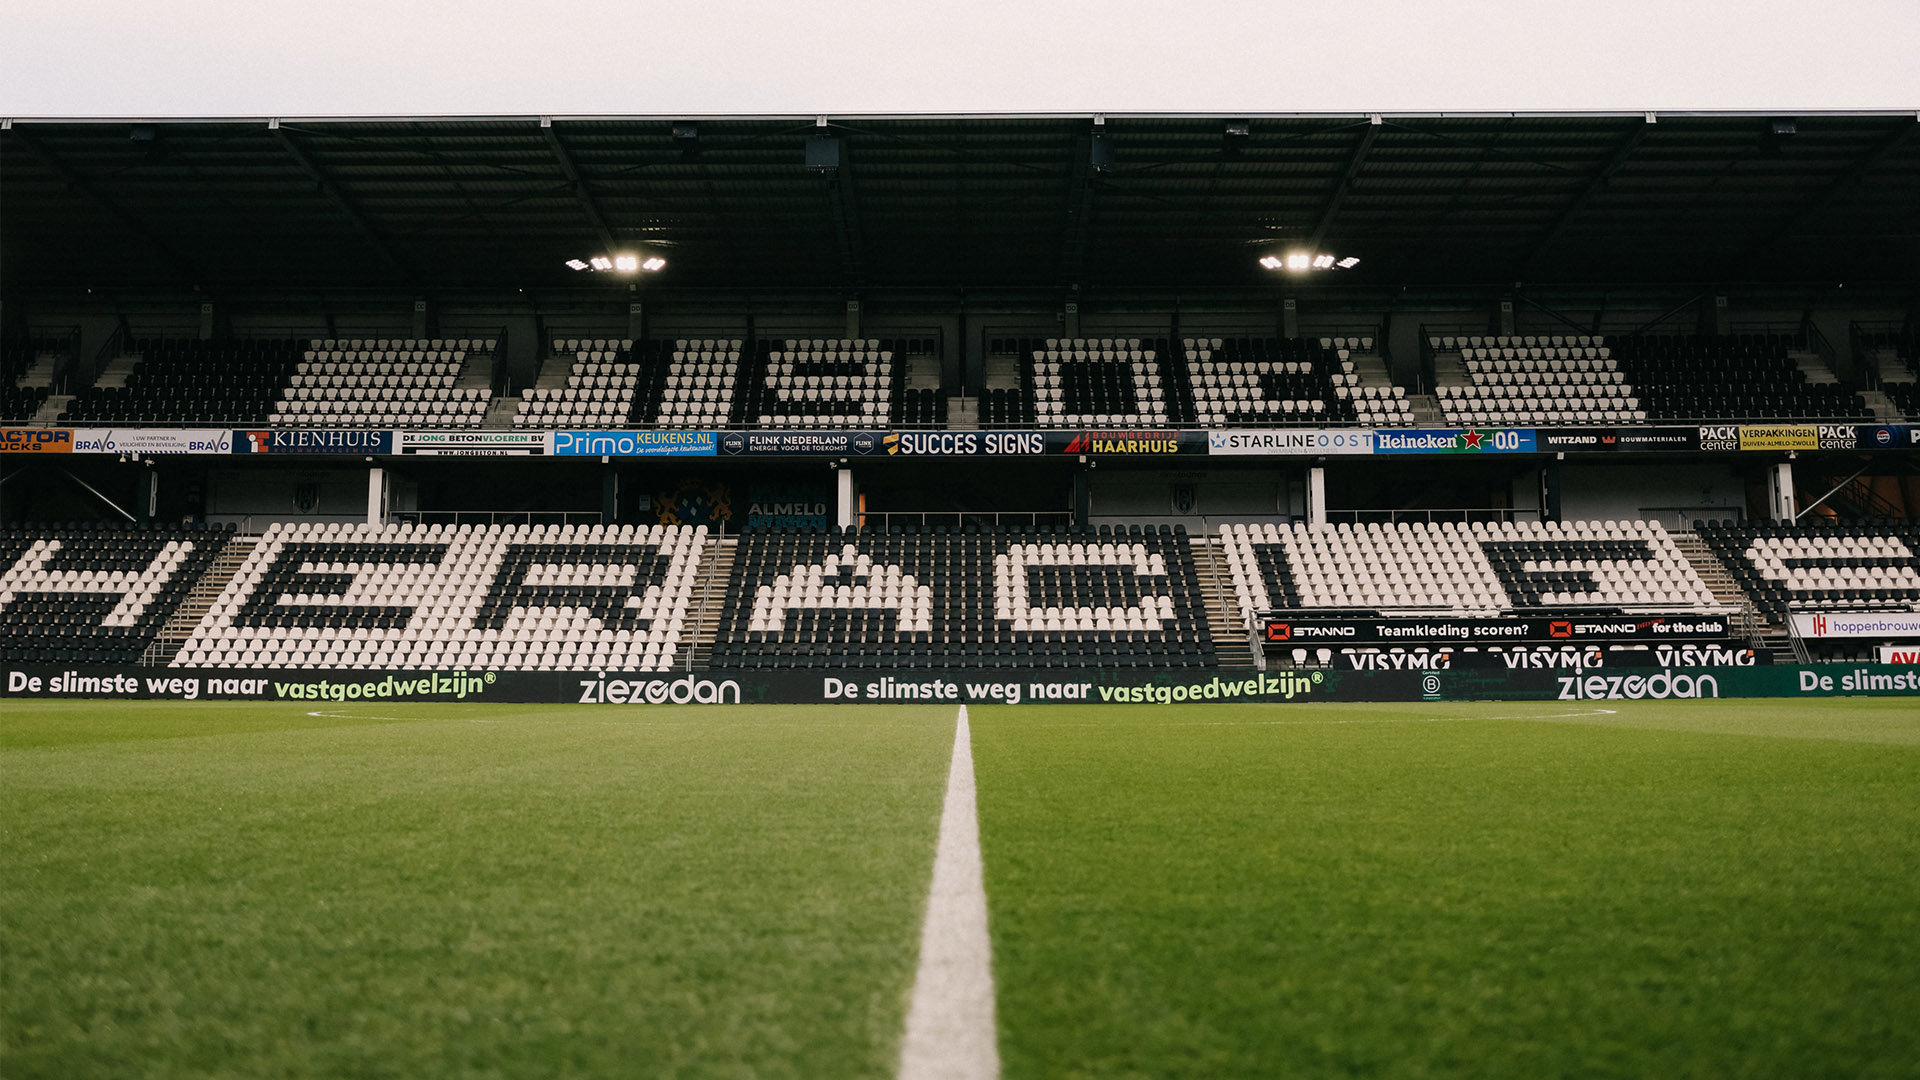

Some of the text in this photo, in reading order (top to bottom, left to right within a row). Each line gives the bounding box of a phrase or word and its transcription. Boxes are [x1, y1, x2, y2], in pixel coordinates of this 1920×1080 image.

[273, 431, 381, 446] KIENHUIS
[636, 433, 713, 444] KEUKENS.NL
[1092, 431, 1179, 439] BOUWBEDRIJF
[1700, 427, 1737, 440] PACK
[1742, 429, 1815, 437] VERPAKKINGEN
[1819, 426, 1856, 439] PACK
[76, 430, 115, 452] BRAVO
[189, 431, 229, 452] BRAVO
[556, 432, 634, 454] Primo
[750, 436, 848, 444] FLINK NEDERLAND
[901, 433, 1043, 454] SUCCES SIGNS
[1092, 440, 1178, 453] HAARHUIS
[1379, 434, 1458, 449] Heineken
[1548, 436, 1597, 444] WITZAND
[1700, 440, 1738, 450] center
[1820, 439, 1857, 449] center
[749, 503, 827, 515] ALMELO
[1293, 626, 1355, 636] STANNO
[1376, 624, 1529, 638] Teamkleding scoren?
[1574, 624, 1636, 634] STANNO
[1652, 622, 1671, 633] for
[1672, 622, 1694, 633] the
[1695, 621, 1723, 633] club
[1890, 652, 1920, 664] AV
[8, 671, 42, 693] De
[49, 671, 139, 694] slimste
[146, 677, 199, 700] weg
[207, 678, 268, 694] naar
[1557, 667, 1718, 700] ziezodan
[1799, 669, 1920, 691] De slimst
[578, 671, 741, 704] ziezodan
[824, 677, 858, 699] De
[866, 677, 958, 699] slimste
[965, 682, 1021, 704] weg
[1029, 683, 1092, 699] naar
